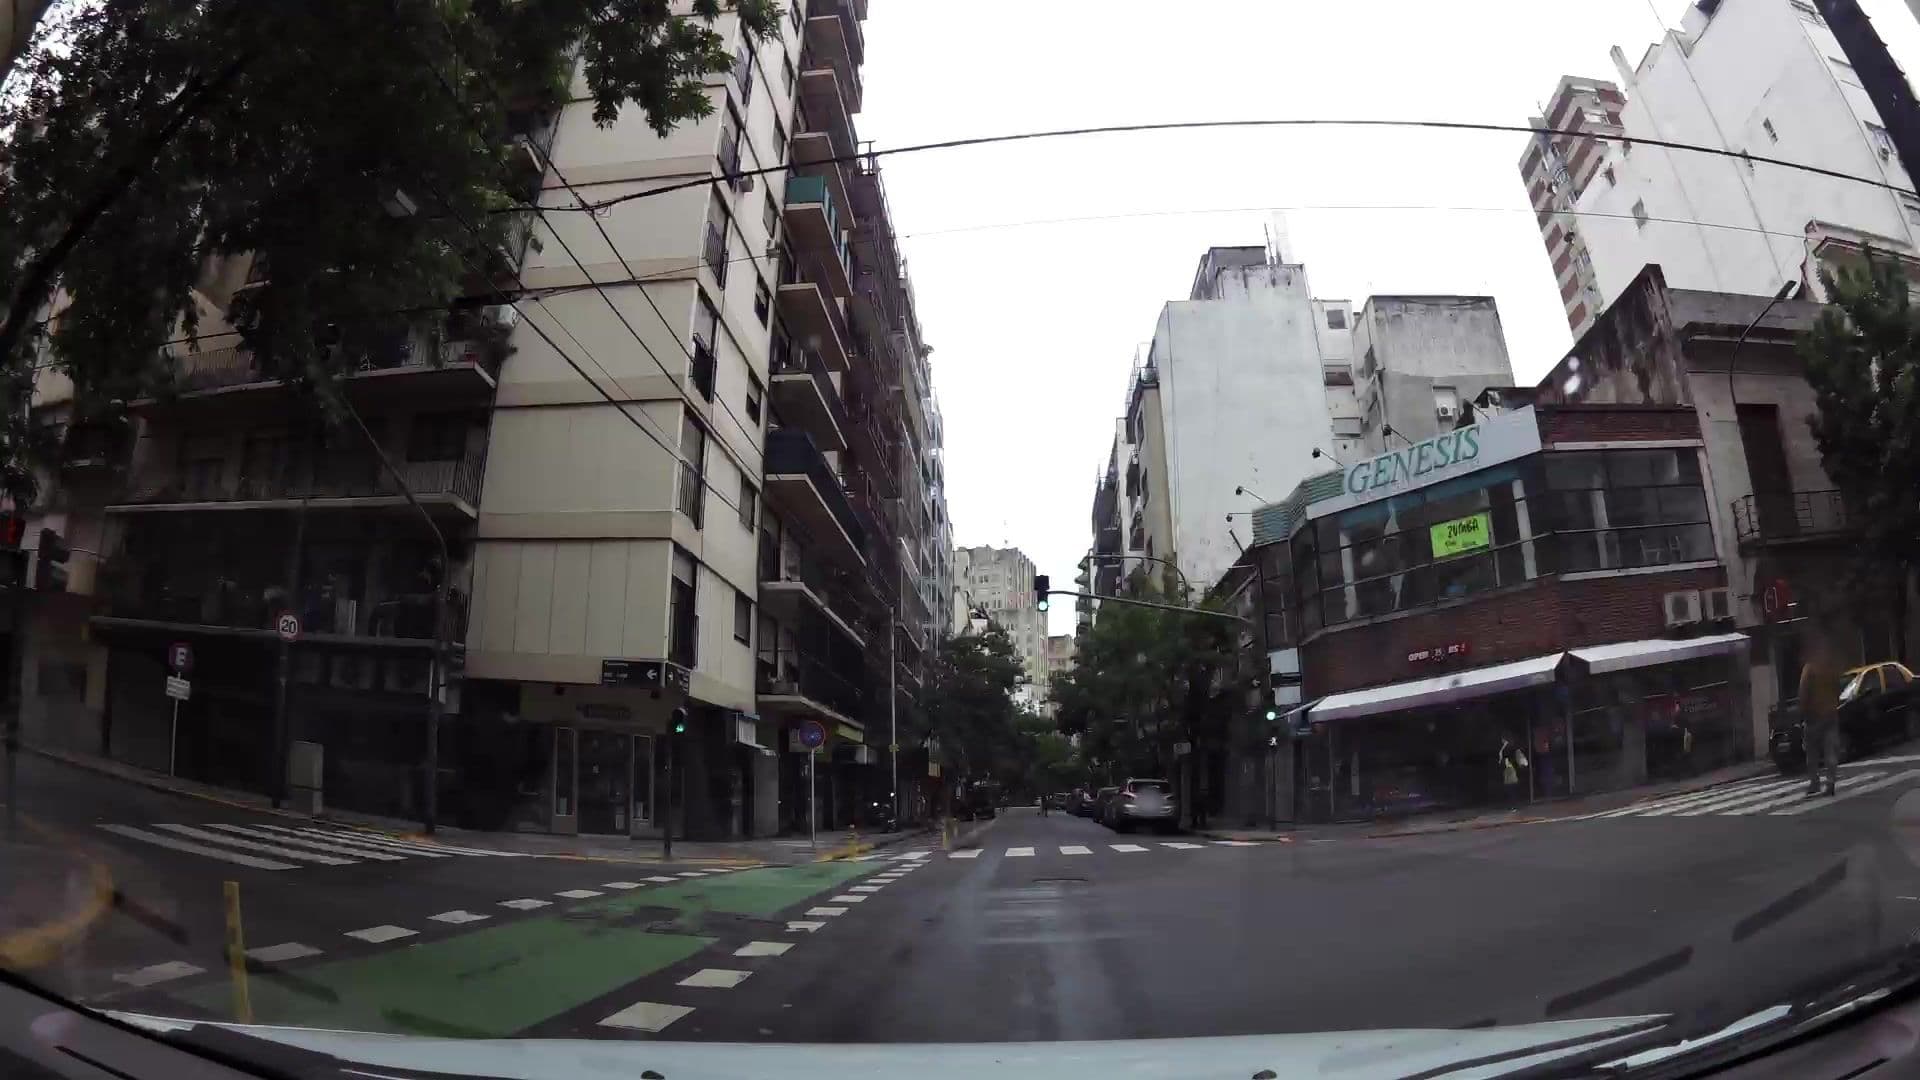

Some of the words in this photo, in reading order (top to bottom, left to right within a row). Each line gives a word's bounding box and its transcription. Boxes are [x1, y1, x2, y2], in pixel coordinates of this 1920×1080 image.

[1348, 425, 1480, 494] GENESIS
[281, 619, 297, 634] 20
[175, 647, 187, 666] E
